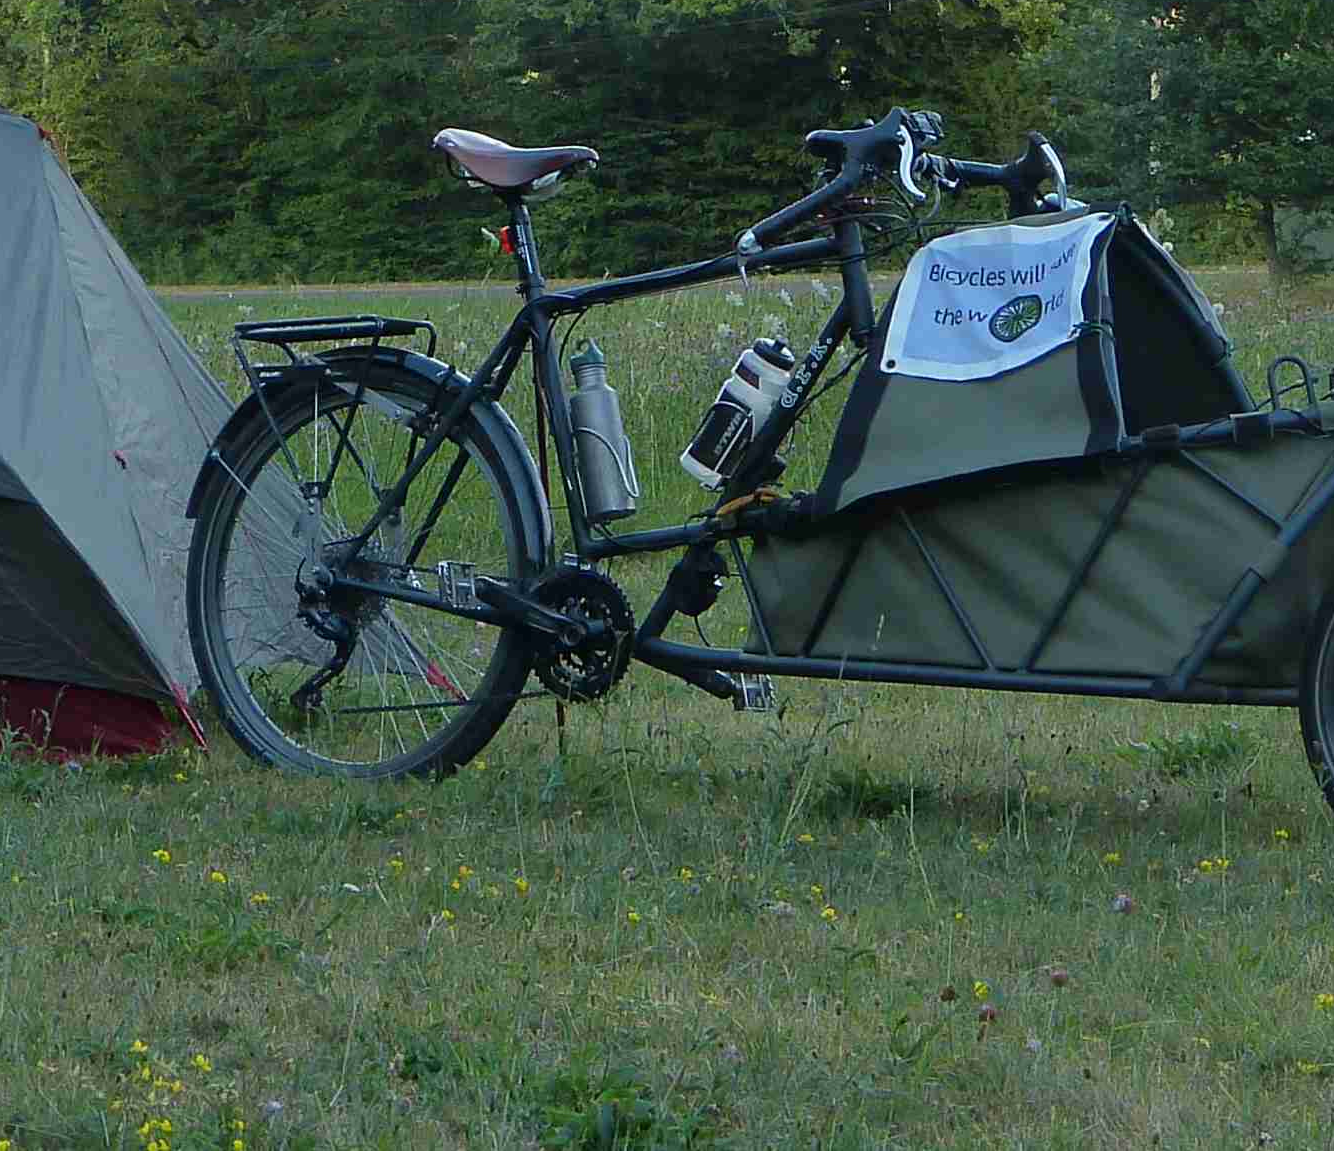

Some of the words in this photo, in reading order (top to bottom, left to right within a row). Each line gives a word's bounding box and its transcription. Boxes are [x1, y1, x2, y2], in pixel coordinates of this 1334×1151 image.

[929, 263, 1006, 286] Bicycles
[1011, 262, 1046, 285] will
[934, 308, 963, 327] the
